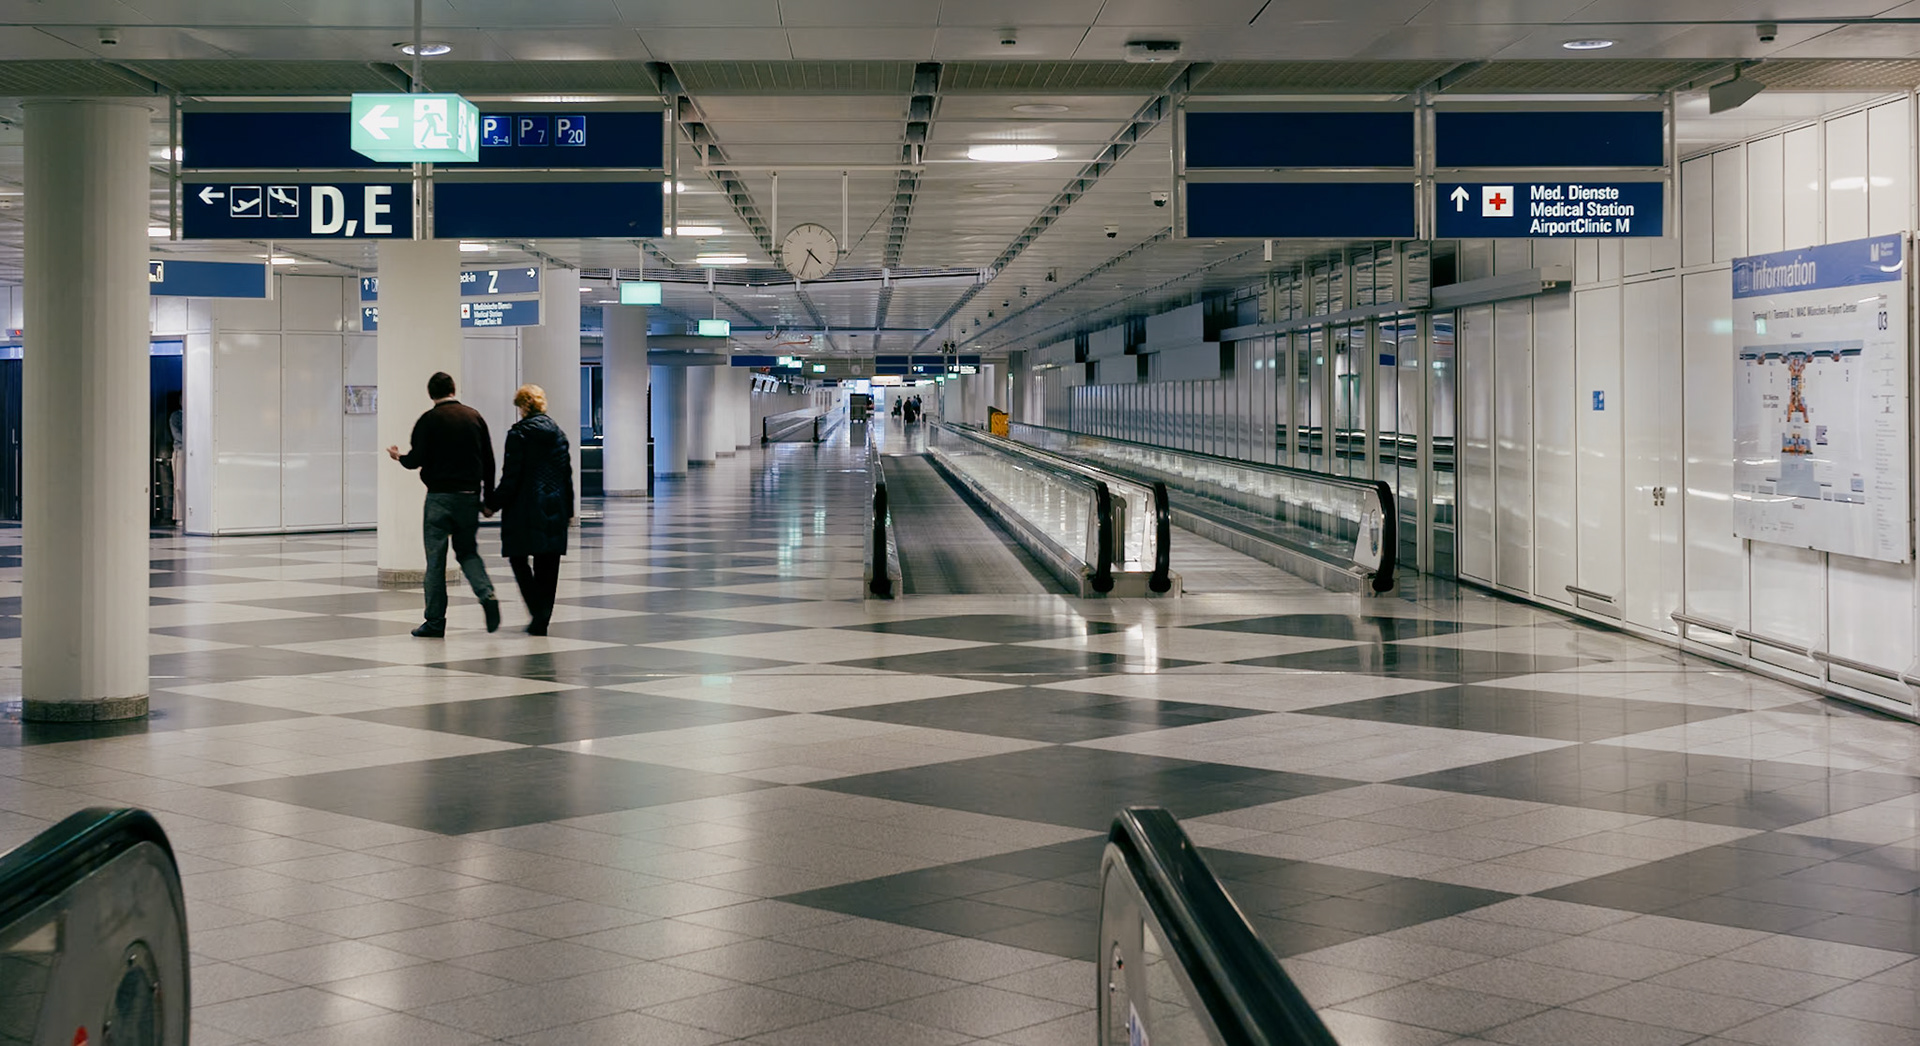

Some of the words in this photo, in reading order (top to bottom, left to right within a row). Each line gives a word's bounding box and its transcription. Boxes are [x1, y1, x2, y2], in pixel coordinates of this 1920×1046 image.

[1530, 184, 1565, 200] Med.
[1568, 184, 1619, 200] Dienste
[1530, 201, 1583, 217] Medical
[1586, 201, 1635, 217] Station
[1529, 217, 1612, 237] AirportClinic
[1615, 218, 1630, 233] M
[488, 270, 499, 293] Z
[1752, 254, 1816, 291] Information
[1878, 311, 1888, 331] 03
